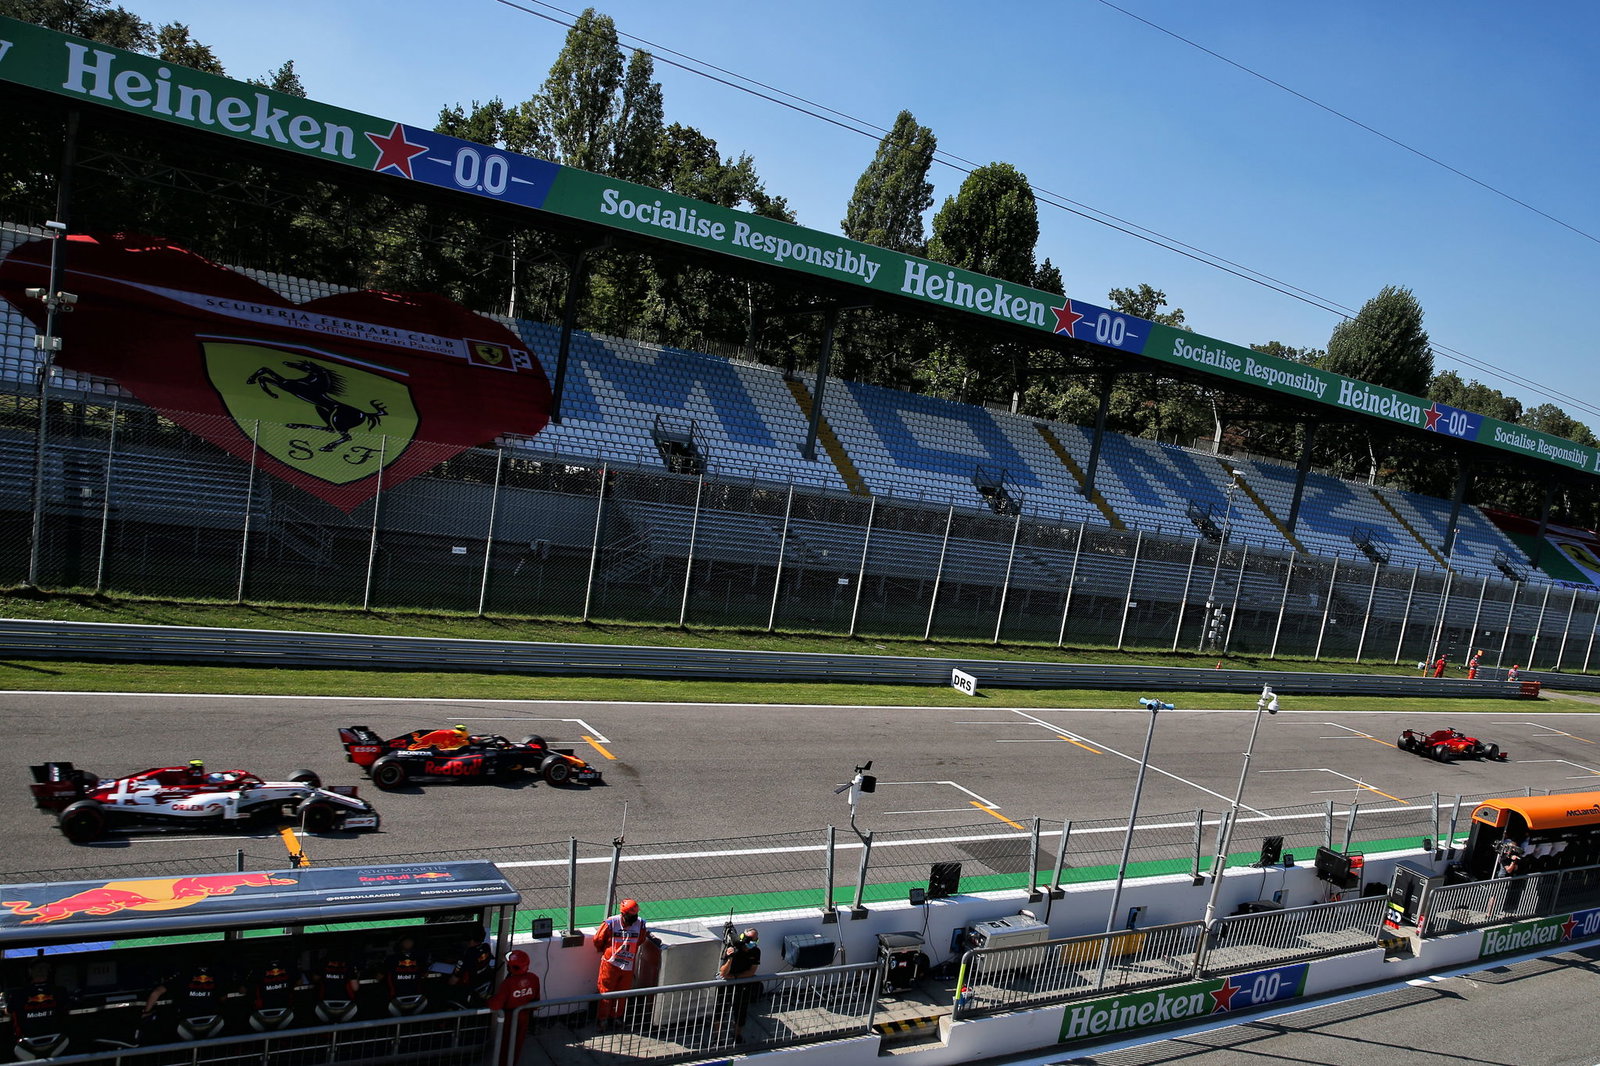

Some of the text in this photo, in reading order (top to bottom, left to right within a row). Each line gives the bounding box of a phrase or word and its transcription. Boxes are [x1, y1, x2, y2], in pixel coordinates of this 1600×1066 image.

[62, 41, 356, 159] Heineken
[600, 188, 881, 284] Socialise Responsibly
[900, 259, 1046, 327] Heineken
[206, 298, 455, 348] SCUDERIA FERRARI CLUB
[287, 318, 456, 355] The Official Ferrari Passion
[1173, 337, 1328, 397] Socialise Responsibly
[1337, 379, 1421, 423] Heineken
[1494, 426, 1536, 451] Socialise
[1536, 438, 1589, 468] Responsibly
[953, 674, 972, 691] DRS
[353, 745, 378, 753] ESSO
[171, 803, 205, 812] ORLEN
[1566, 808, 1600, 817] McLaren
[357, 865, 448, 875] ASTON MARTIN
[385, 873, 411, 881] Bull
[362, 877, 456, 886] RACING
[326, 892, 401, 902] @REDBULLRACING
[420, 886, 503, 896] REDBULLRACING.COM
[1482, 923, 1559, 956] Heineken
[512, 987, 533, 998] CEA
[26, 1010, 47, 1019] Mobil
[1064, 990, 1205, 1040] Heineken
